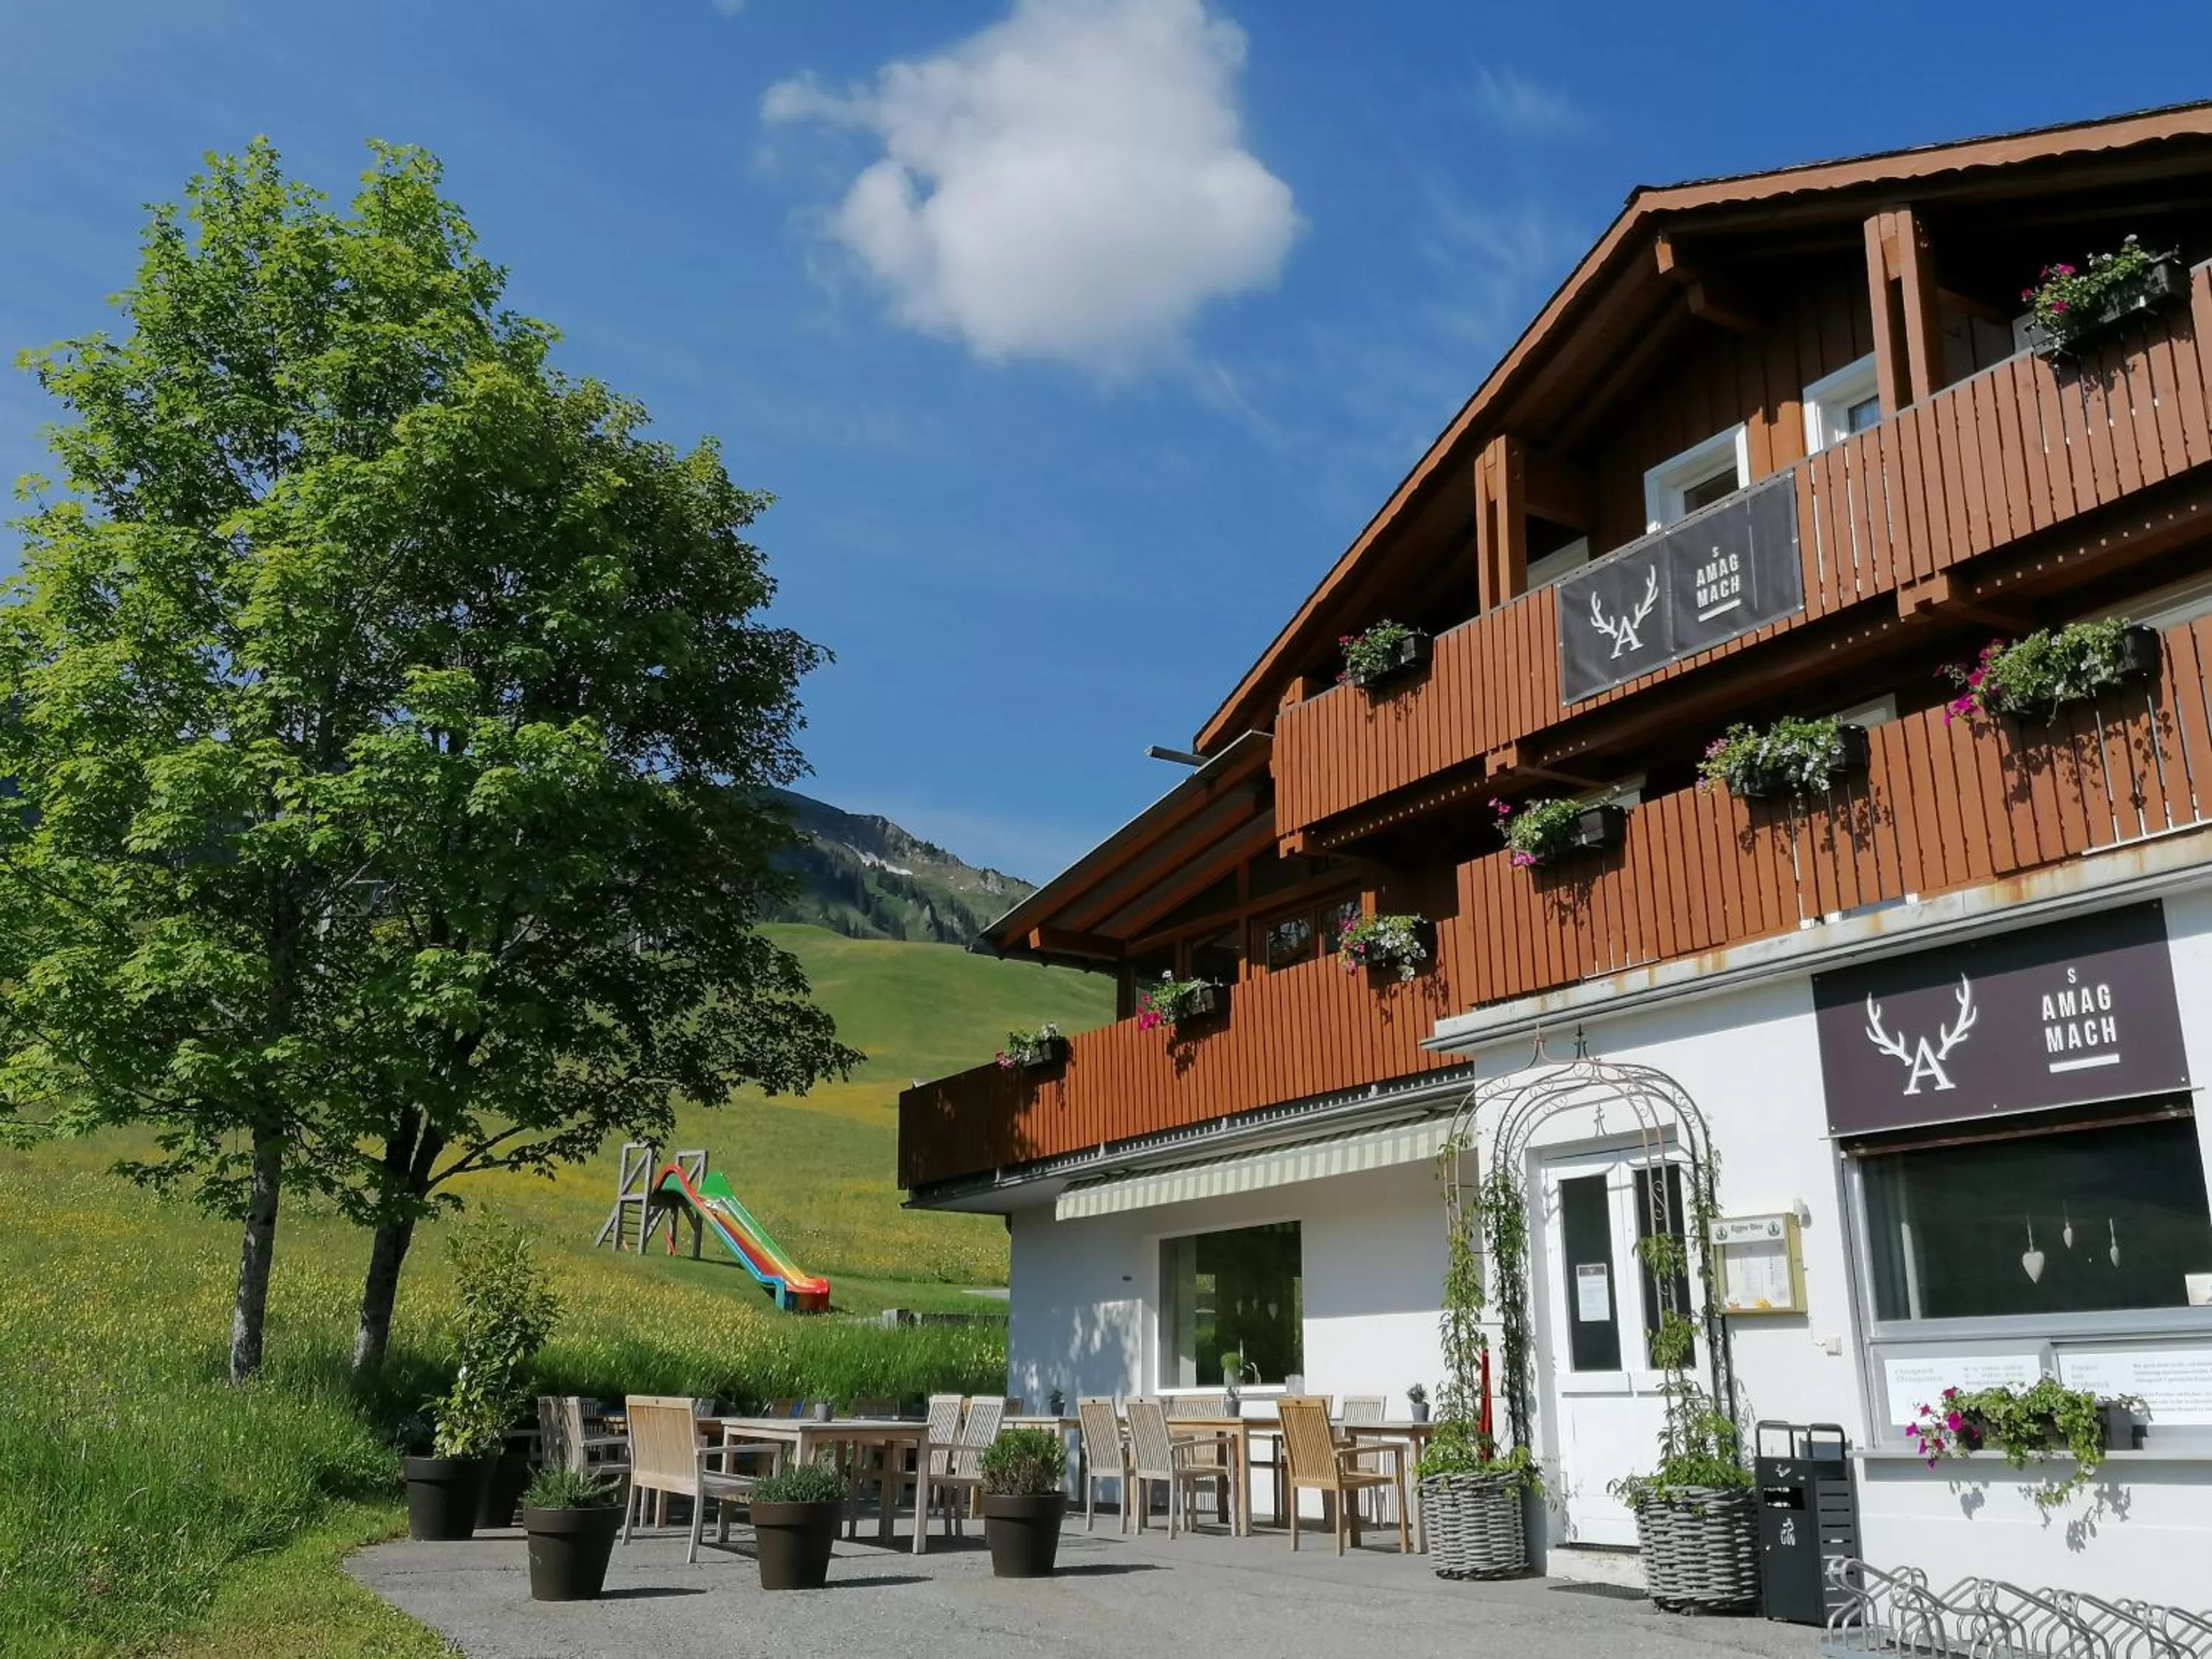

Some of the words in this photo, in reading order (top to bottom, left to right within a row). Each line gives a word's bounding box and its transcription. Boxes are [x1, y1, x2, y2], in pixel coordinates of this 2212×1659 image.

[1712, 546, 1719, 557] S
[1696, 553, 1739, 588] AMAG
[1697, 574, 1740, 608] MACH
[2067, 967, 2076, 984] S
[2042, 984, 2112, 1020] AMAG
[2045, 1016, 2117, 1053] MACH
